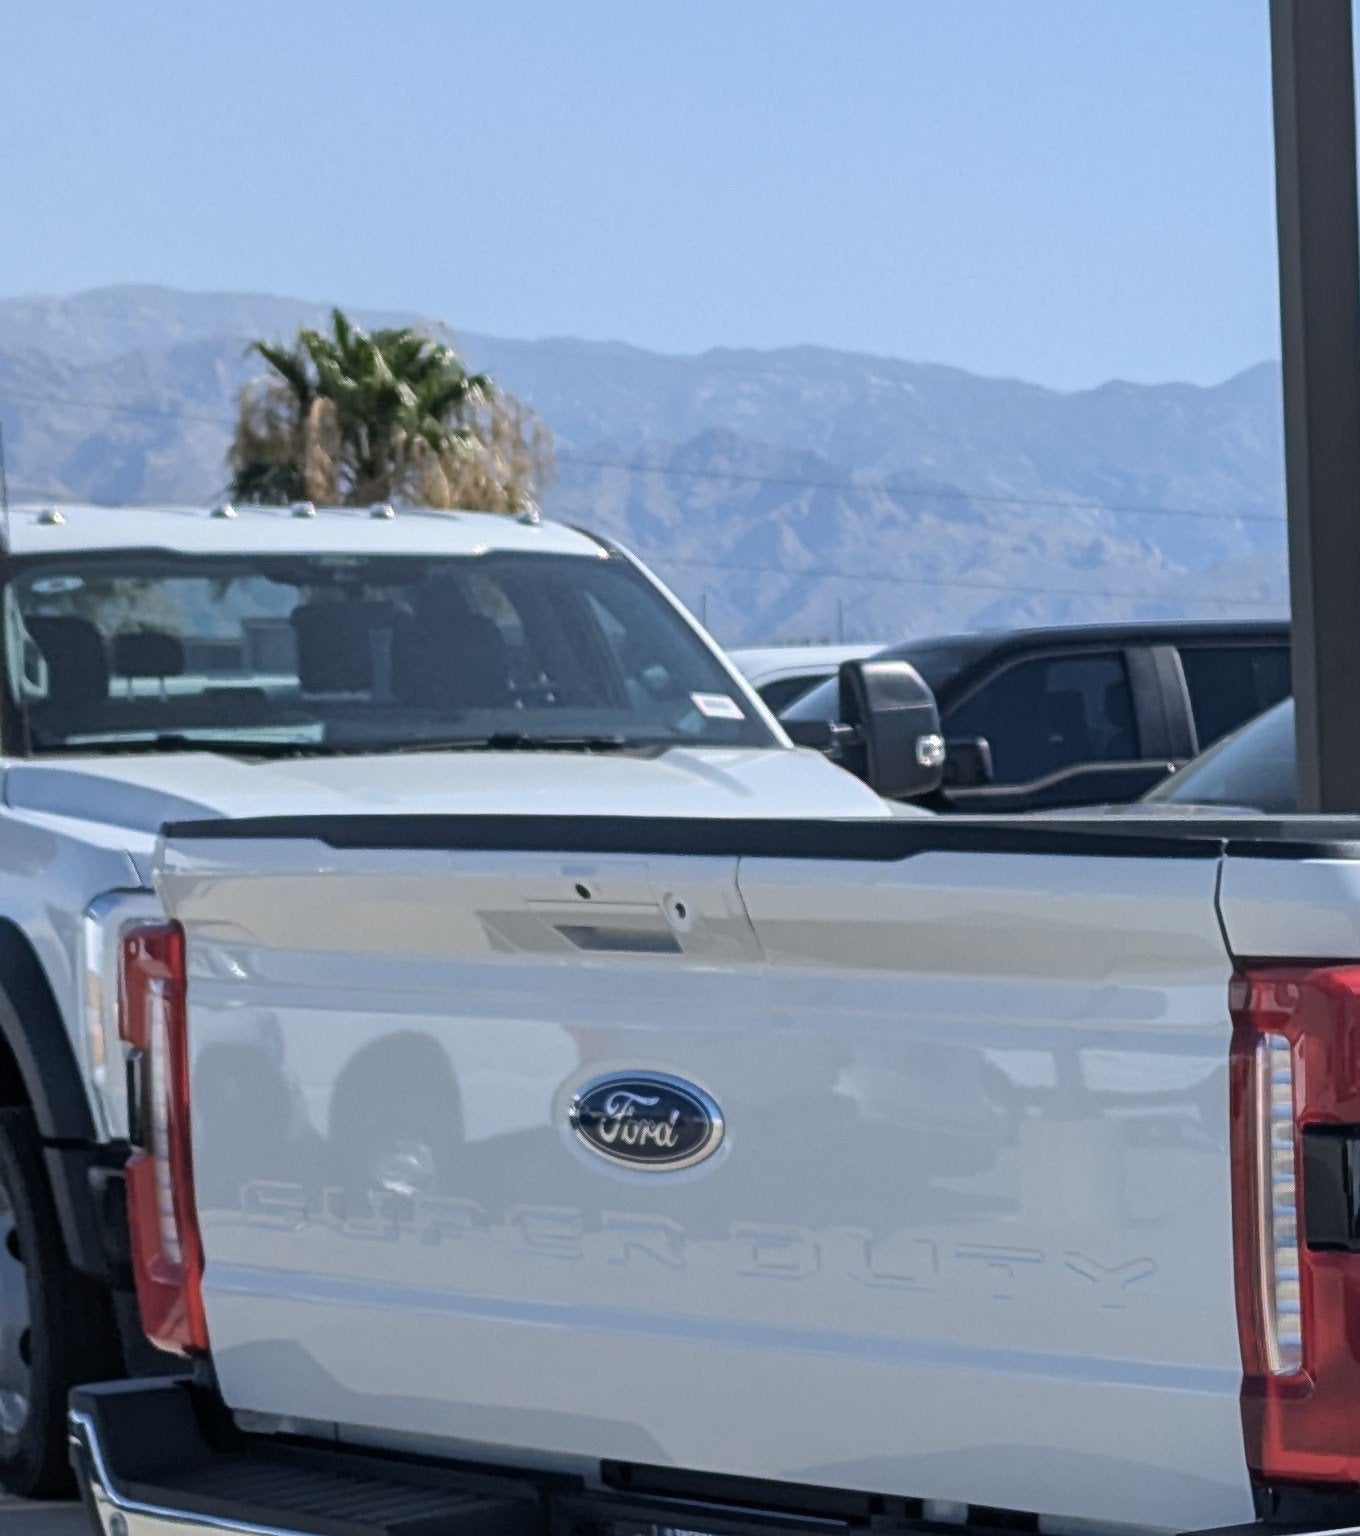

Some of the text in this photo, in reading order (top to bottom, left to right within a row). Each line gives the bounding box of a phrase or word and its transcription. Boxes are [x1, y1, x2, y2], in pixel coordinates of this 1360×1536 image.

[598, 1090, 679, 1148] Ford
[239, 1180, 1158, 1309] SUPER DUTY
